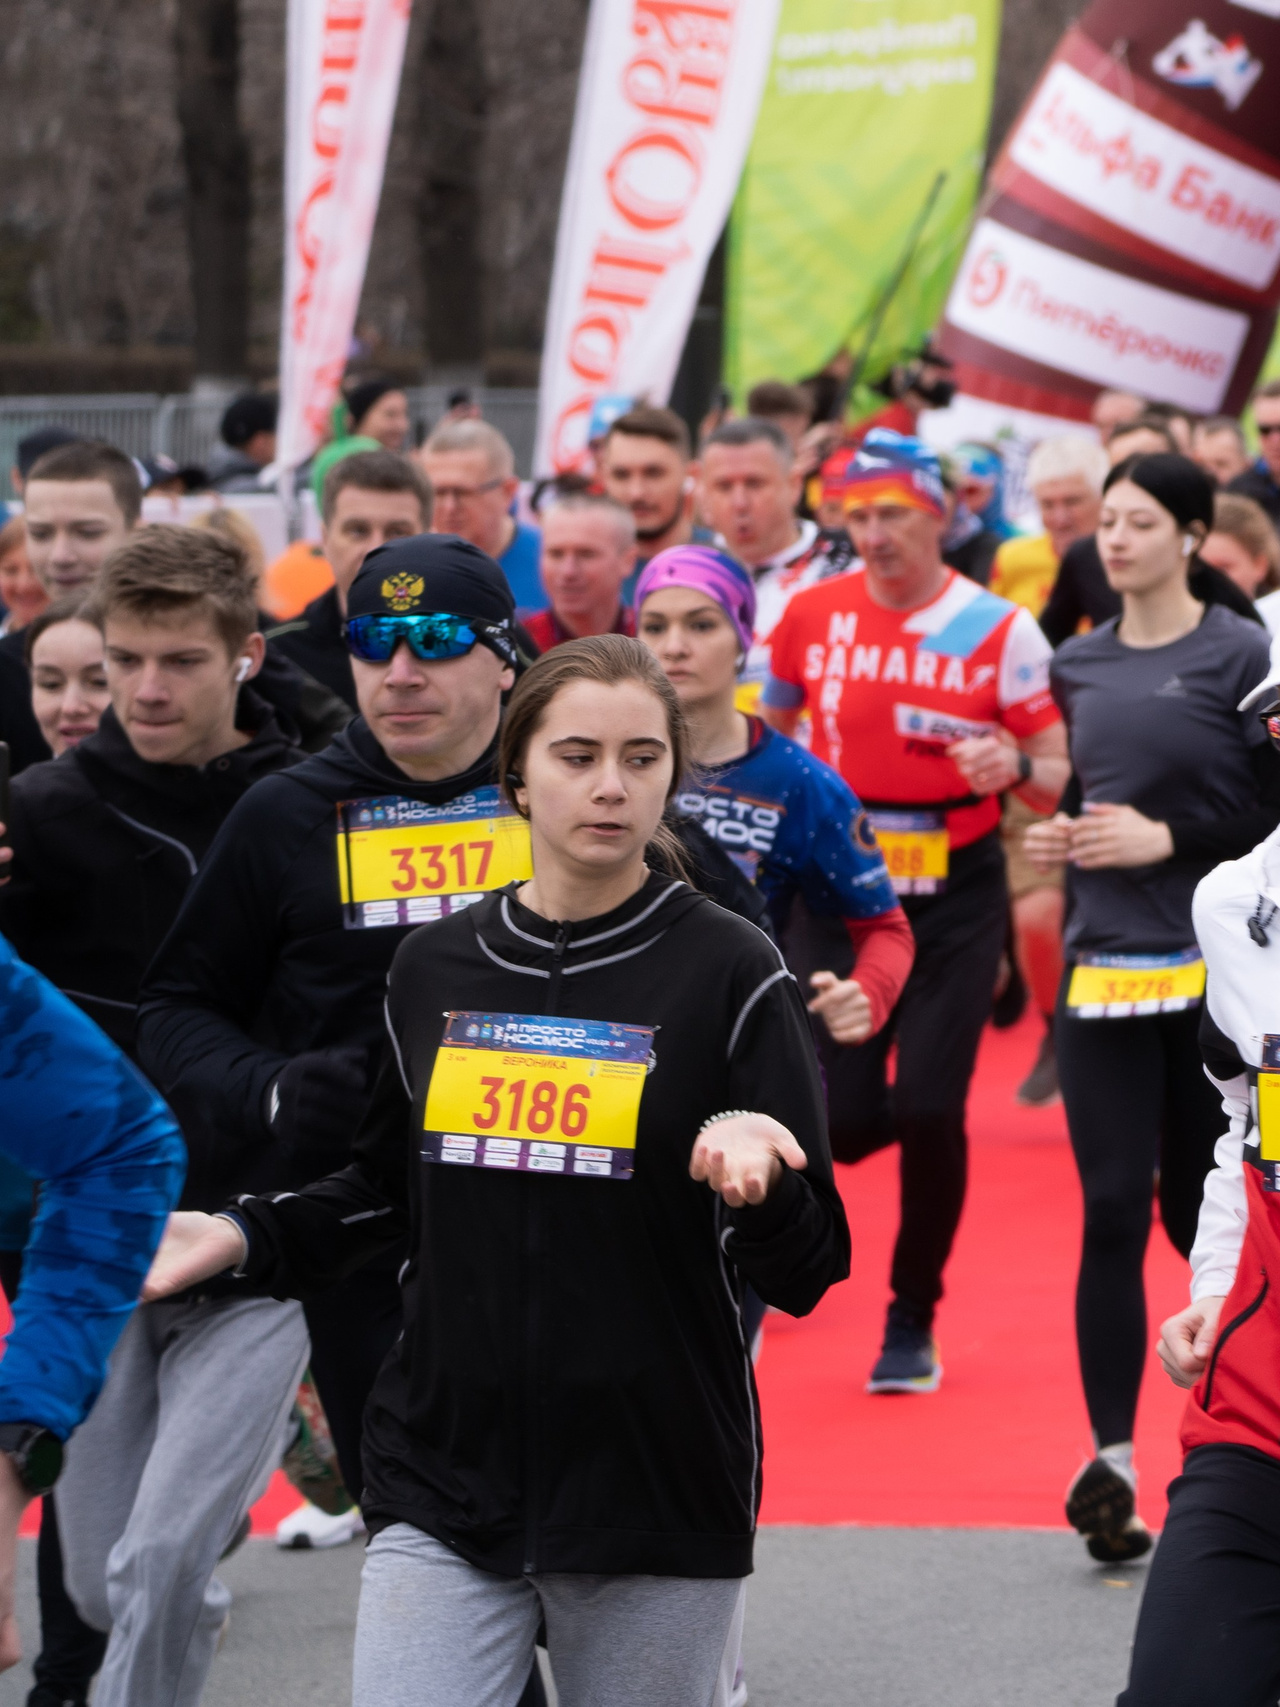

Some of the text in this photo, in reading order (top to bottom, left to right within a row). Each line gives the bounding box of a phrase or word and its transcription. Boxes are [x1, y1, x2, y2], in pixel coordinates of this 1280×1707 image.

[804, 643, 966, 694] SAMARA
[397, 803, 477, 822] КОСМОС
[390, 841, 494, 892] 3317
[518, 1024, 588, 1038] ПРОСТО
[503, 1033, 586, 1049] КОСМОС
[502, 1055, 568, 1071] ВЕРОНИКА
[472, 1076, 592, 1137] 3186
